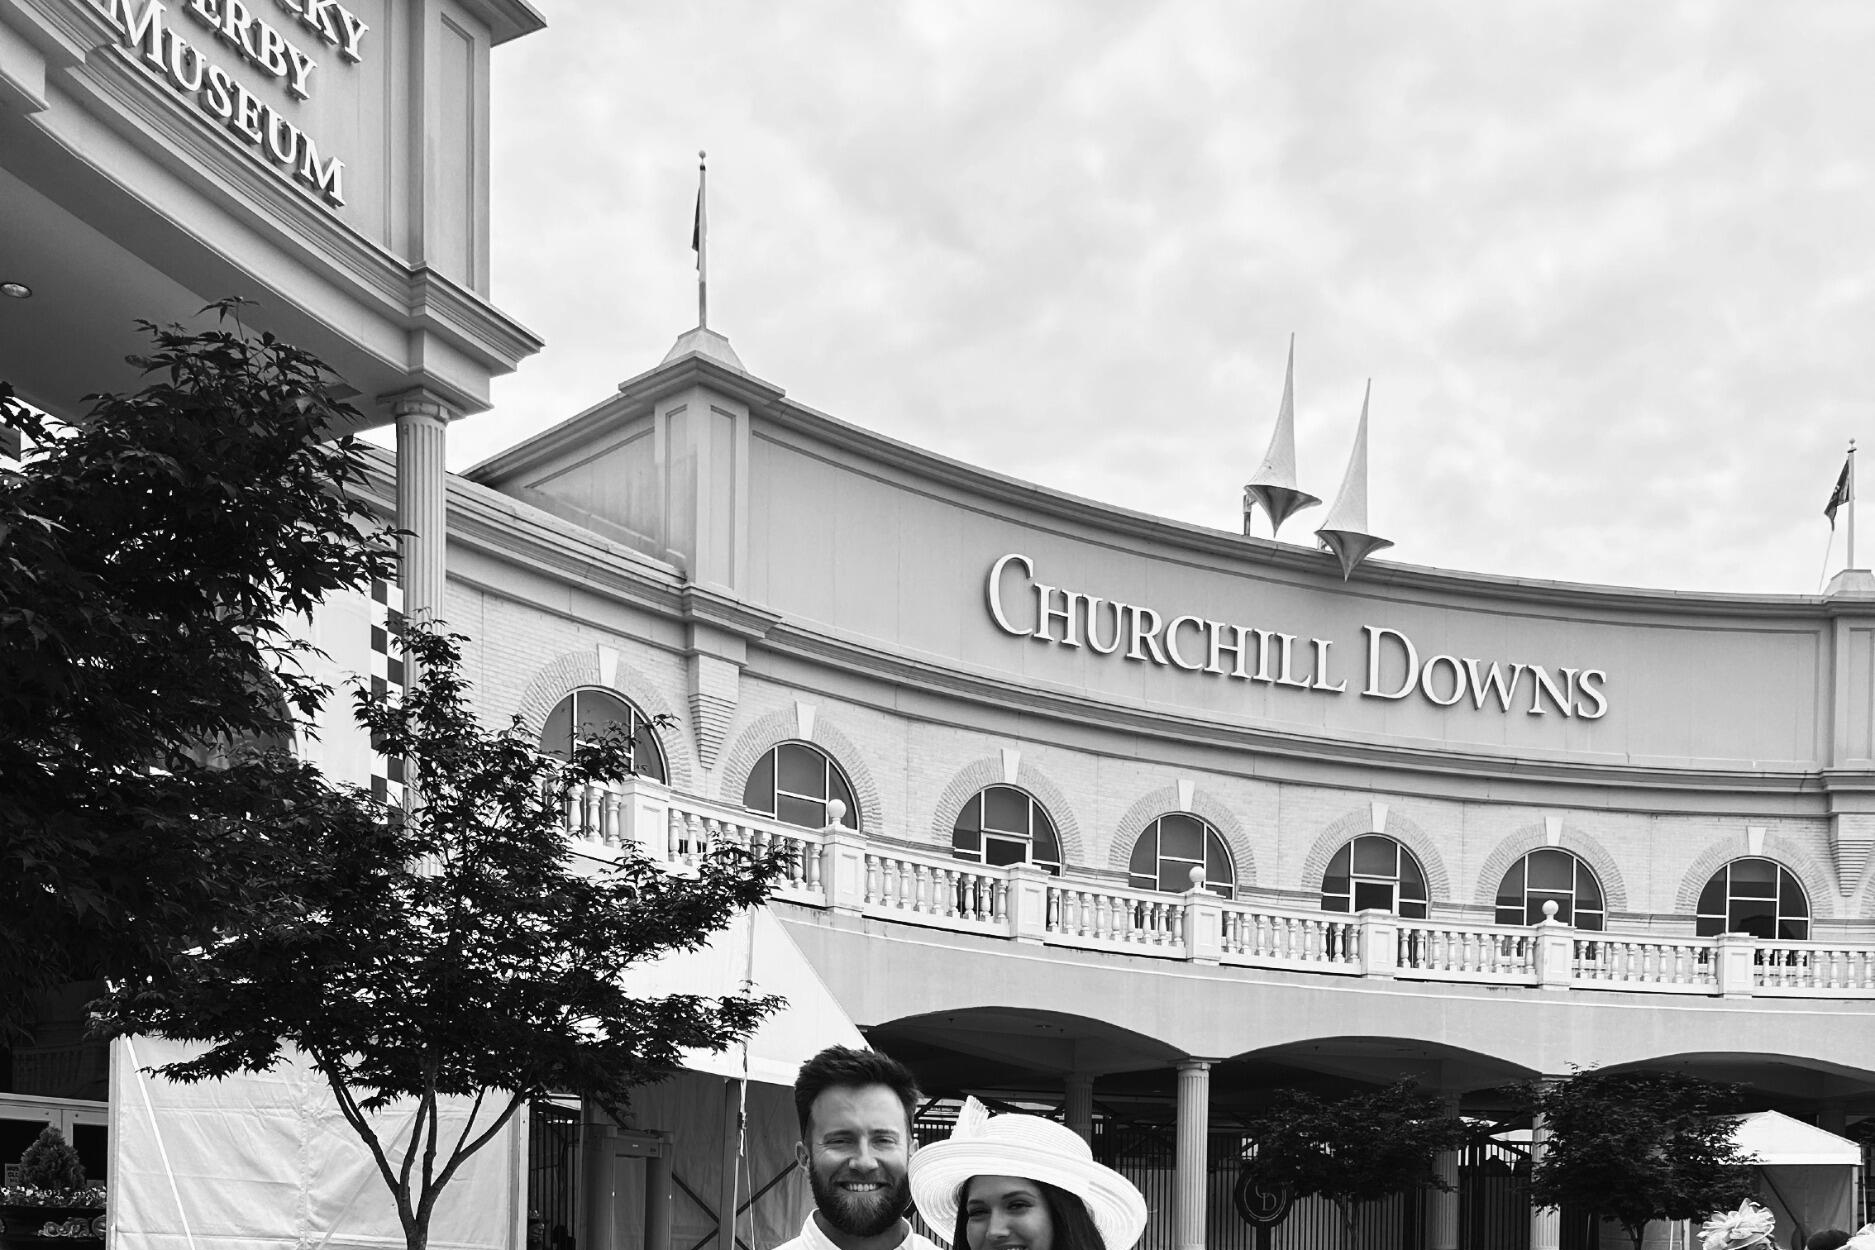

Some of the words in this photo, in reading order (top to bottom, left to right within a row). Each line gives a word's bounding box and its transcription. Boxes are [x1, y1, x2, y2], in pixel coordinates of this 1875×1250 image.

[107, 0, 346, 207] MUSEUM
[987, 553, 1346, 692] CHURCHILL
[1362, 624, 1608, 719] DOWNS
